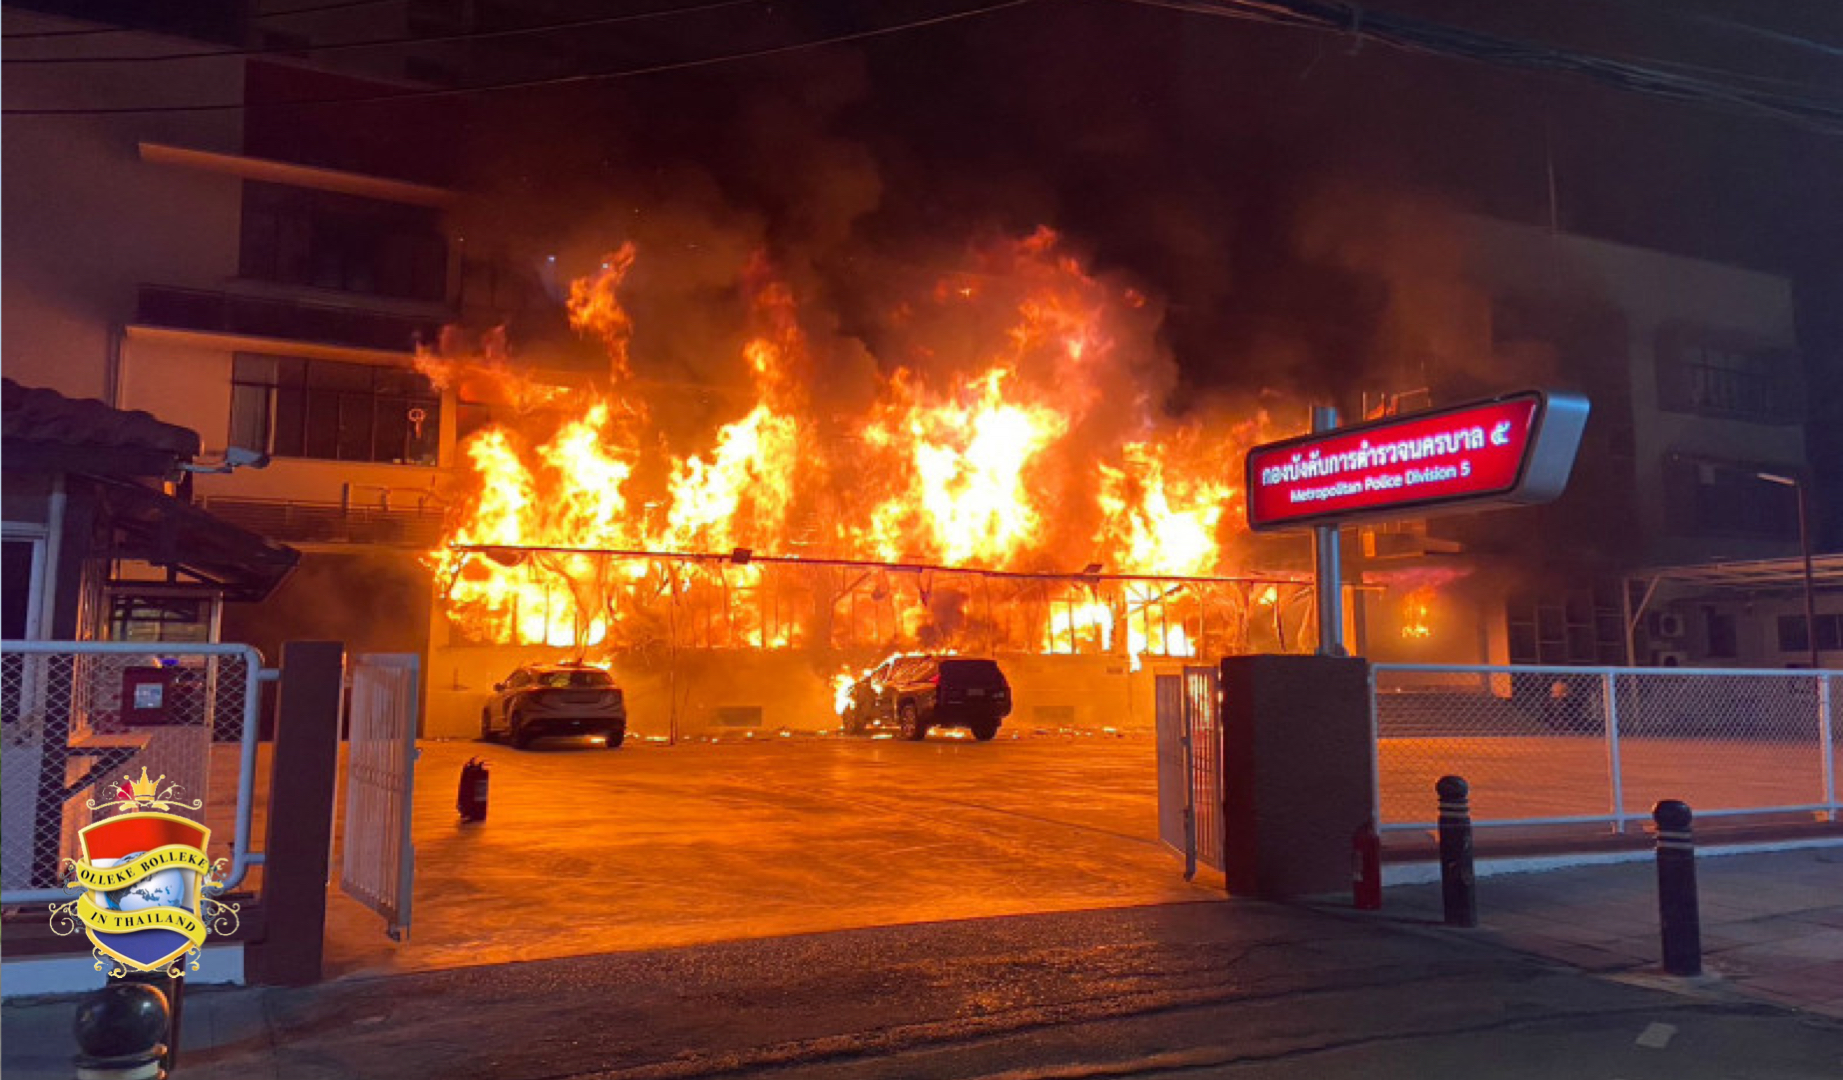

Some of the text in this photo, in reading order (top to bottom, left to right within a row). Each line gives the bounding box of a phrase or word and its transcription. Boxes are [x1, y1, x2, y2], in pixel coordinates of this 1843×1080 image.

[1262, 420, 1511, 487] กองบังคับการตำรวจนครบาล ๕
[1290, 460, 1471, 503] Metropolitan Police Division 5
